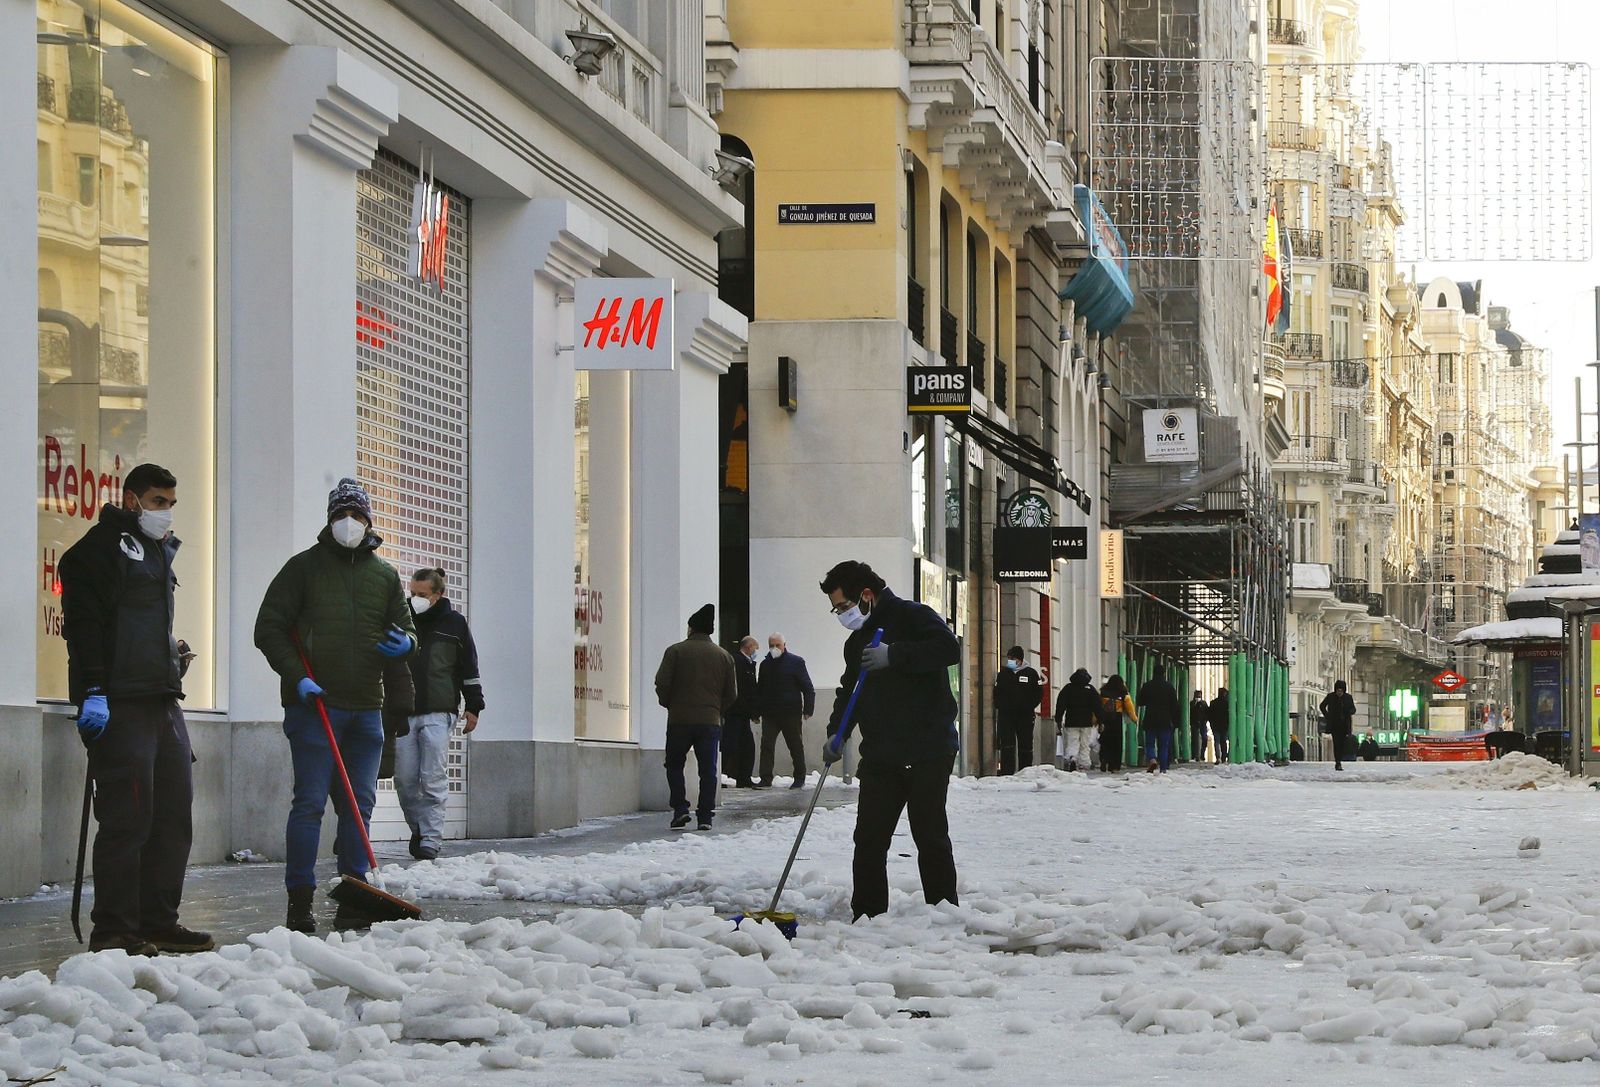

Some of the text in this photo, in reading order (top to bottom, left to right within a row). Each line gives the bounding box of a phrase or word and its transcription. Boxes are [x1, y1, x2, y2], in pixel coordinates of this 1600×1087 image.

[790, 212, 814, 221] GONZALO
[840, 212, 847, 221] DE
[849, 212, 873, 222] QUESADA
[583, 297, 664, 350] H&M
[914, 373, 965, 395] pans
[930, 393, 965, 403] & COMPANY
[1156, 433, 1186, 442] RAFE
[1052, 539, 1084, 547] CIMAS
[1105, 532, 1115, 590] stradivarius
